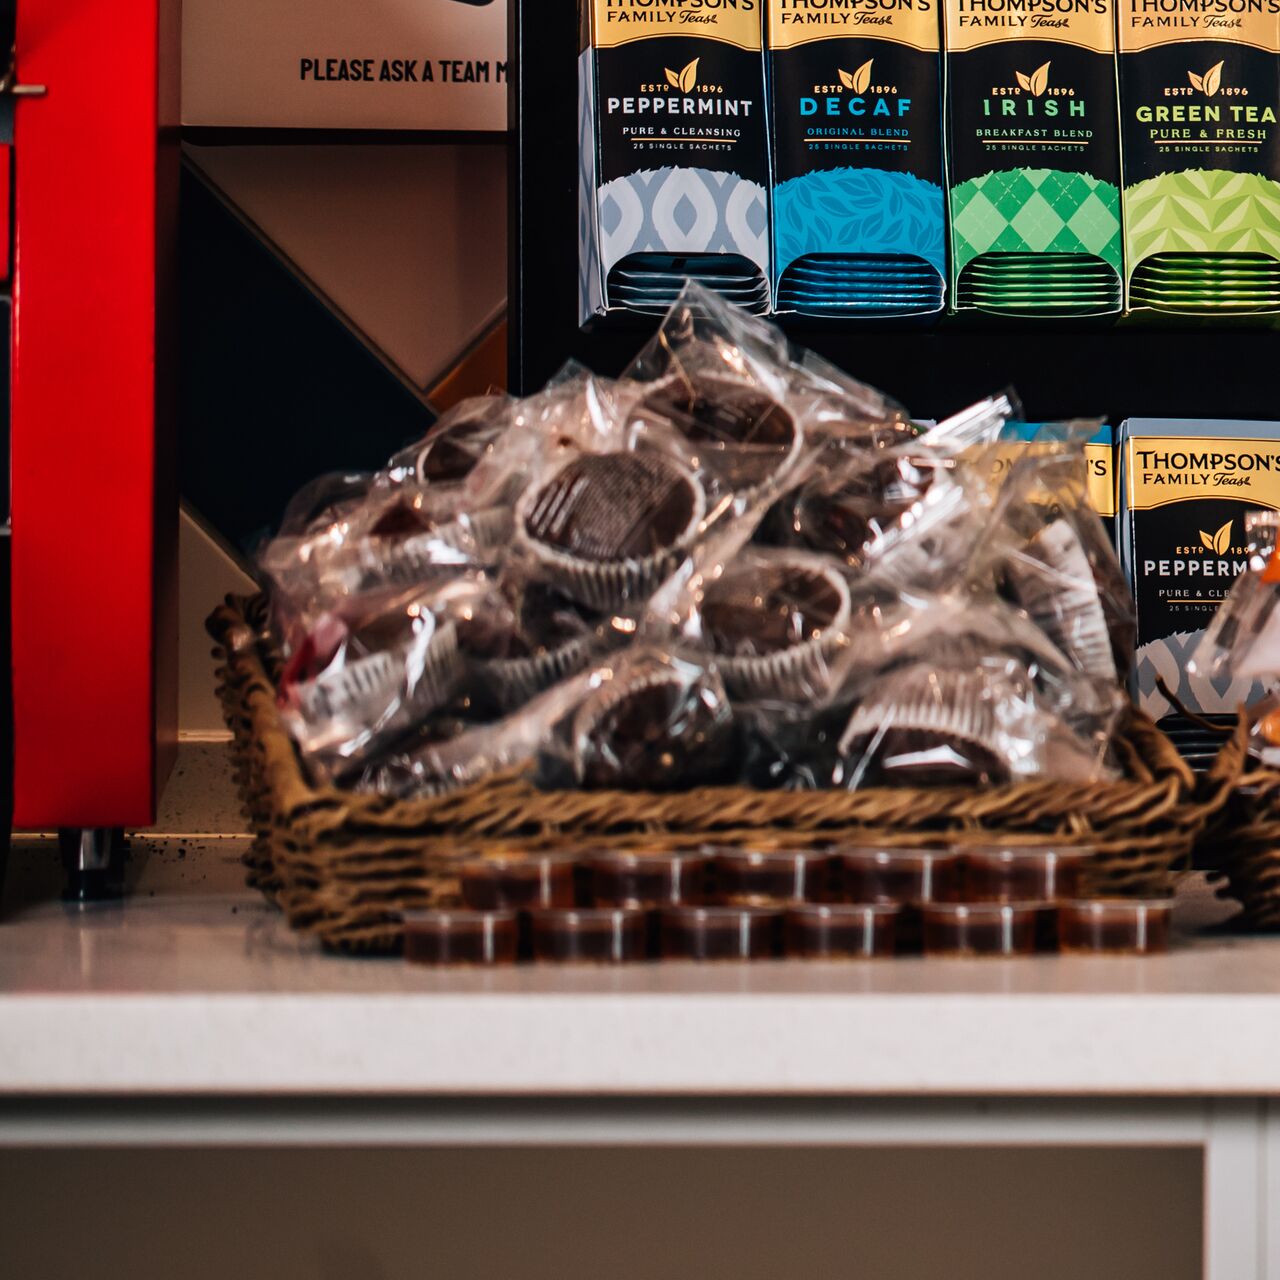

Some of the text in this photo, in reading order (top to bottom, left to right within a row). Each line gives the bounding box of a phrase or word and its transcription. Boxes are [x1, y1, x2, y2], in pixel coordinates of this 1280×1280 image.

[608, 10, 712, 25] FAMILY Teas
[781, 11, 886, 26] FAMILY Teas
[959, 14, 1063, 29] FAMILY Teas
[1131, 14, 1237, 29] FAMILY Teas
[300, 59, 374, 83] PLEASE
[379, 60, 418, 83] ASK
[421, 61, 434, 83] A
[438, 60, 490, 84] TEAM
[696, 85, 723, 93] 1896
[870, 86, 898, 94] 1896
[1048, 88, 1075, 96] 1896
[1220, 88, 1248, 96] 1896
[607, 97, 752, 117] PEPPERMINT
[800, 97, 912, 117] DECAF
[983, 99, 1086, 117] IRISH
[1136, 106, 1277, 123] GREEN TEA
[622, 126, 741, 137] PURE & CLEANSING
[807, 127, 909, 137] ORIGINAL BLEND
[976, 128, 1093, 138] BREAKFAST BLEND
[1150, 129, 1266, 139] PURE & FRESH
[689, 143, 732, 151] SACHETS
[824, 143, 855, 151] SINGLE
[864, 143, 908, 151] SACHETS
[1174, 145, 1210, 153] SINGLE
[1143, 472, 1246, 487] FAMILY Teas
[1144, 559, 1248, 577] PEPPERM
[1158, 589, 1190, 598] PURE
